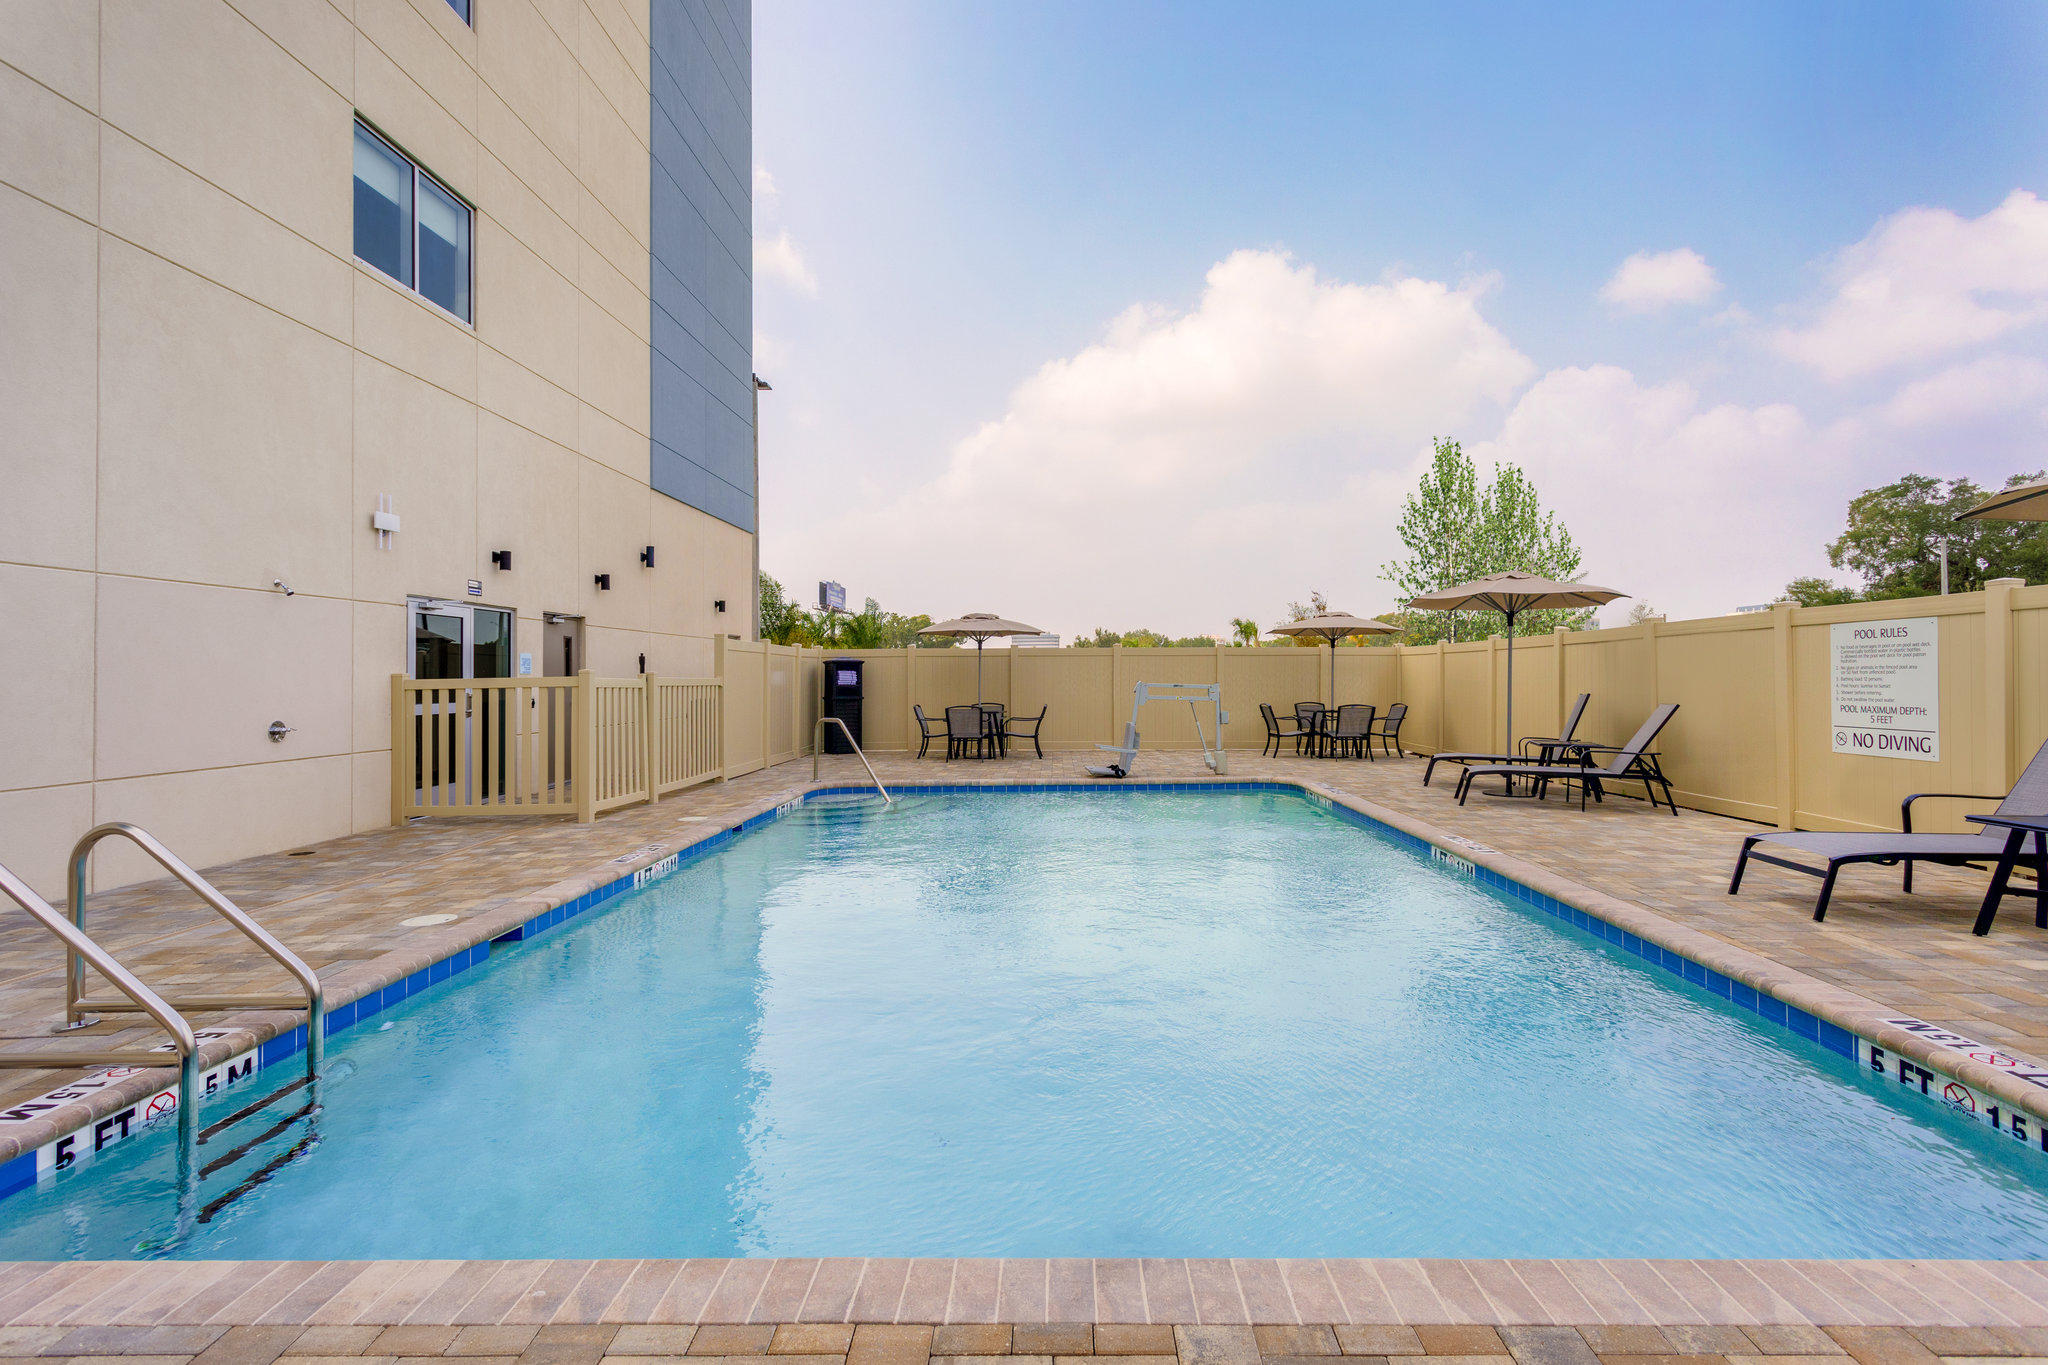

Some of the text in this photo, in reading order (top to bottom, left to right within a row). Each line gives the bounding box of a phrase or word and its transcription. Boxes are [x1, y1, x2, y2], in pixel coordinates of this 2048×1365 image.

[1854, 626, 1908, 640] POOL RULES
[1840, 704, 1928, 716] POOL MAXIMUM DEPTH:
[1870, 715, 1894, 724] 5 FEET
[1853, 732, 1932, 754] NO DIVING
[1870, 1045, 1886, 1074] 5
[1899, 1058, 1935, 1096] FT
[55, 1134, 76, 1170] 5
[94, 1107, 136, 1152] FT
[228, 1056, 252, 1086] M
